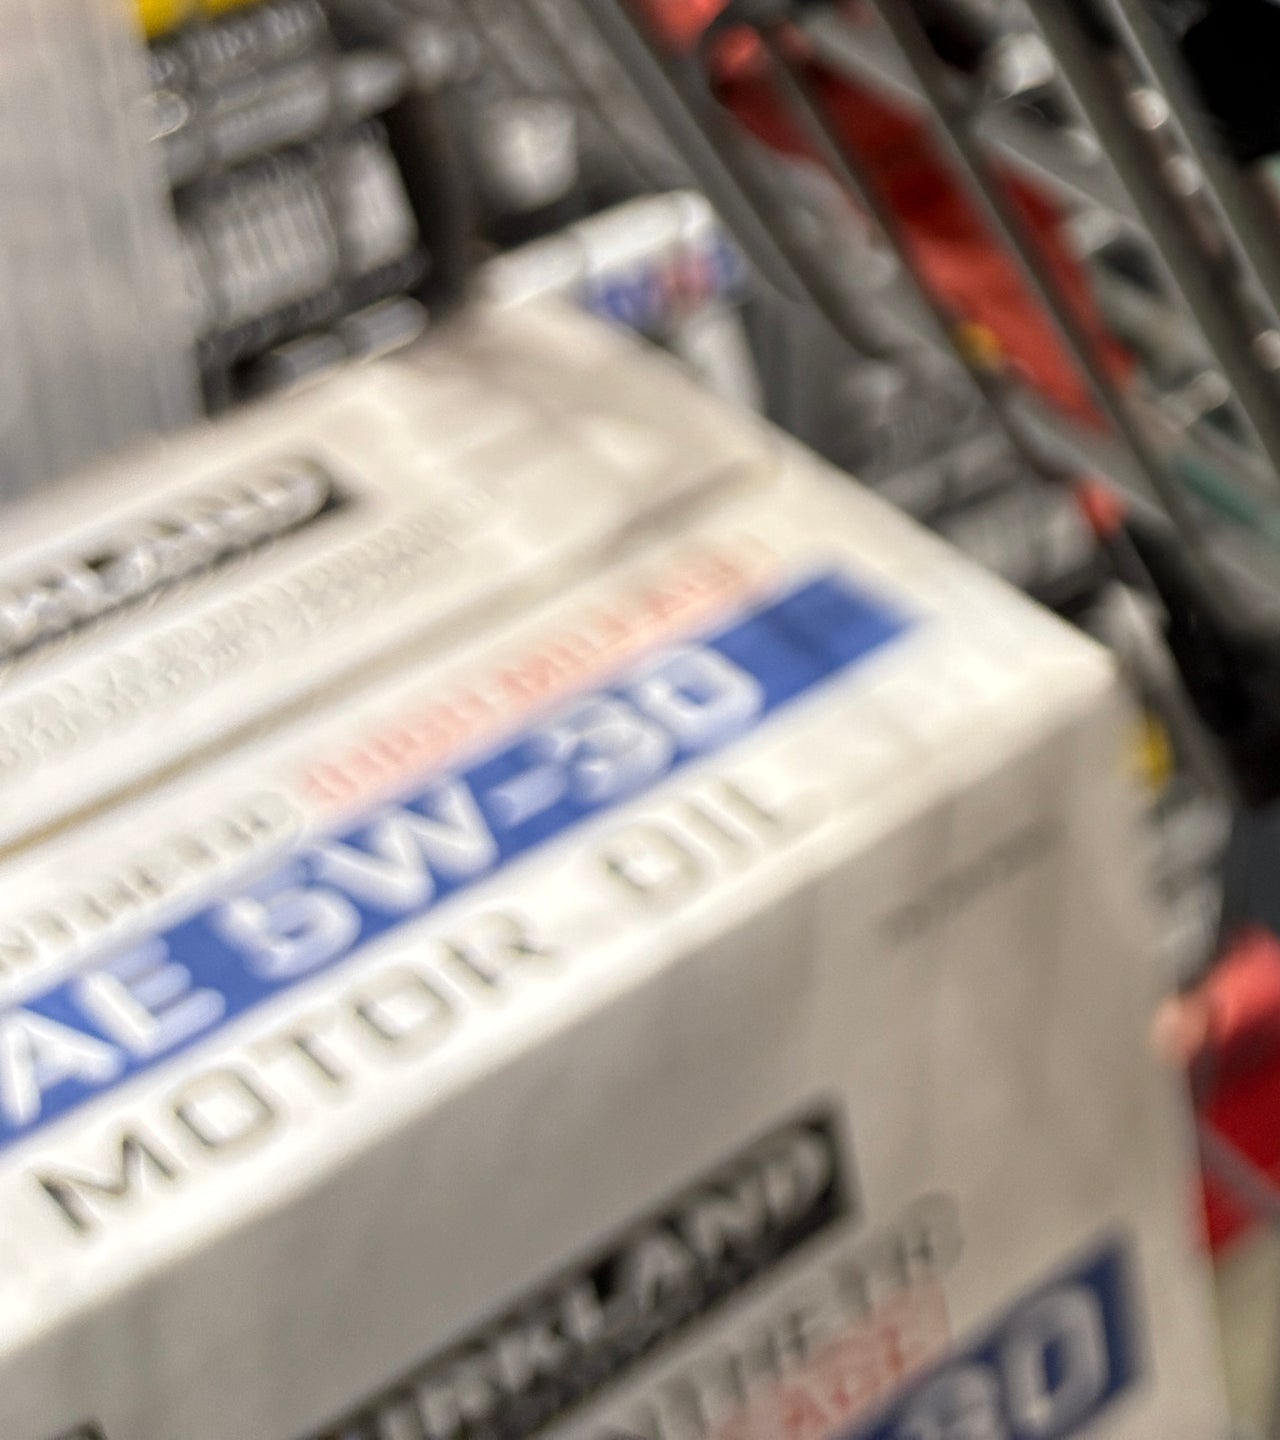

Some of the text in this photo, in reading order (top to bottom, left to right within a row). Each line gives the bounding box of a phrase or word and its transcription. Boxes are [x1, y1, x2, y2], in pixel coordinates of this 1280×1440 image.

[36, 905, 562, 1242] MOTOR
[598, 768, 805, 910] OIL
[208, 640, 768, 982] 5W-30
